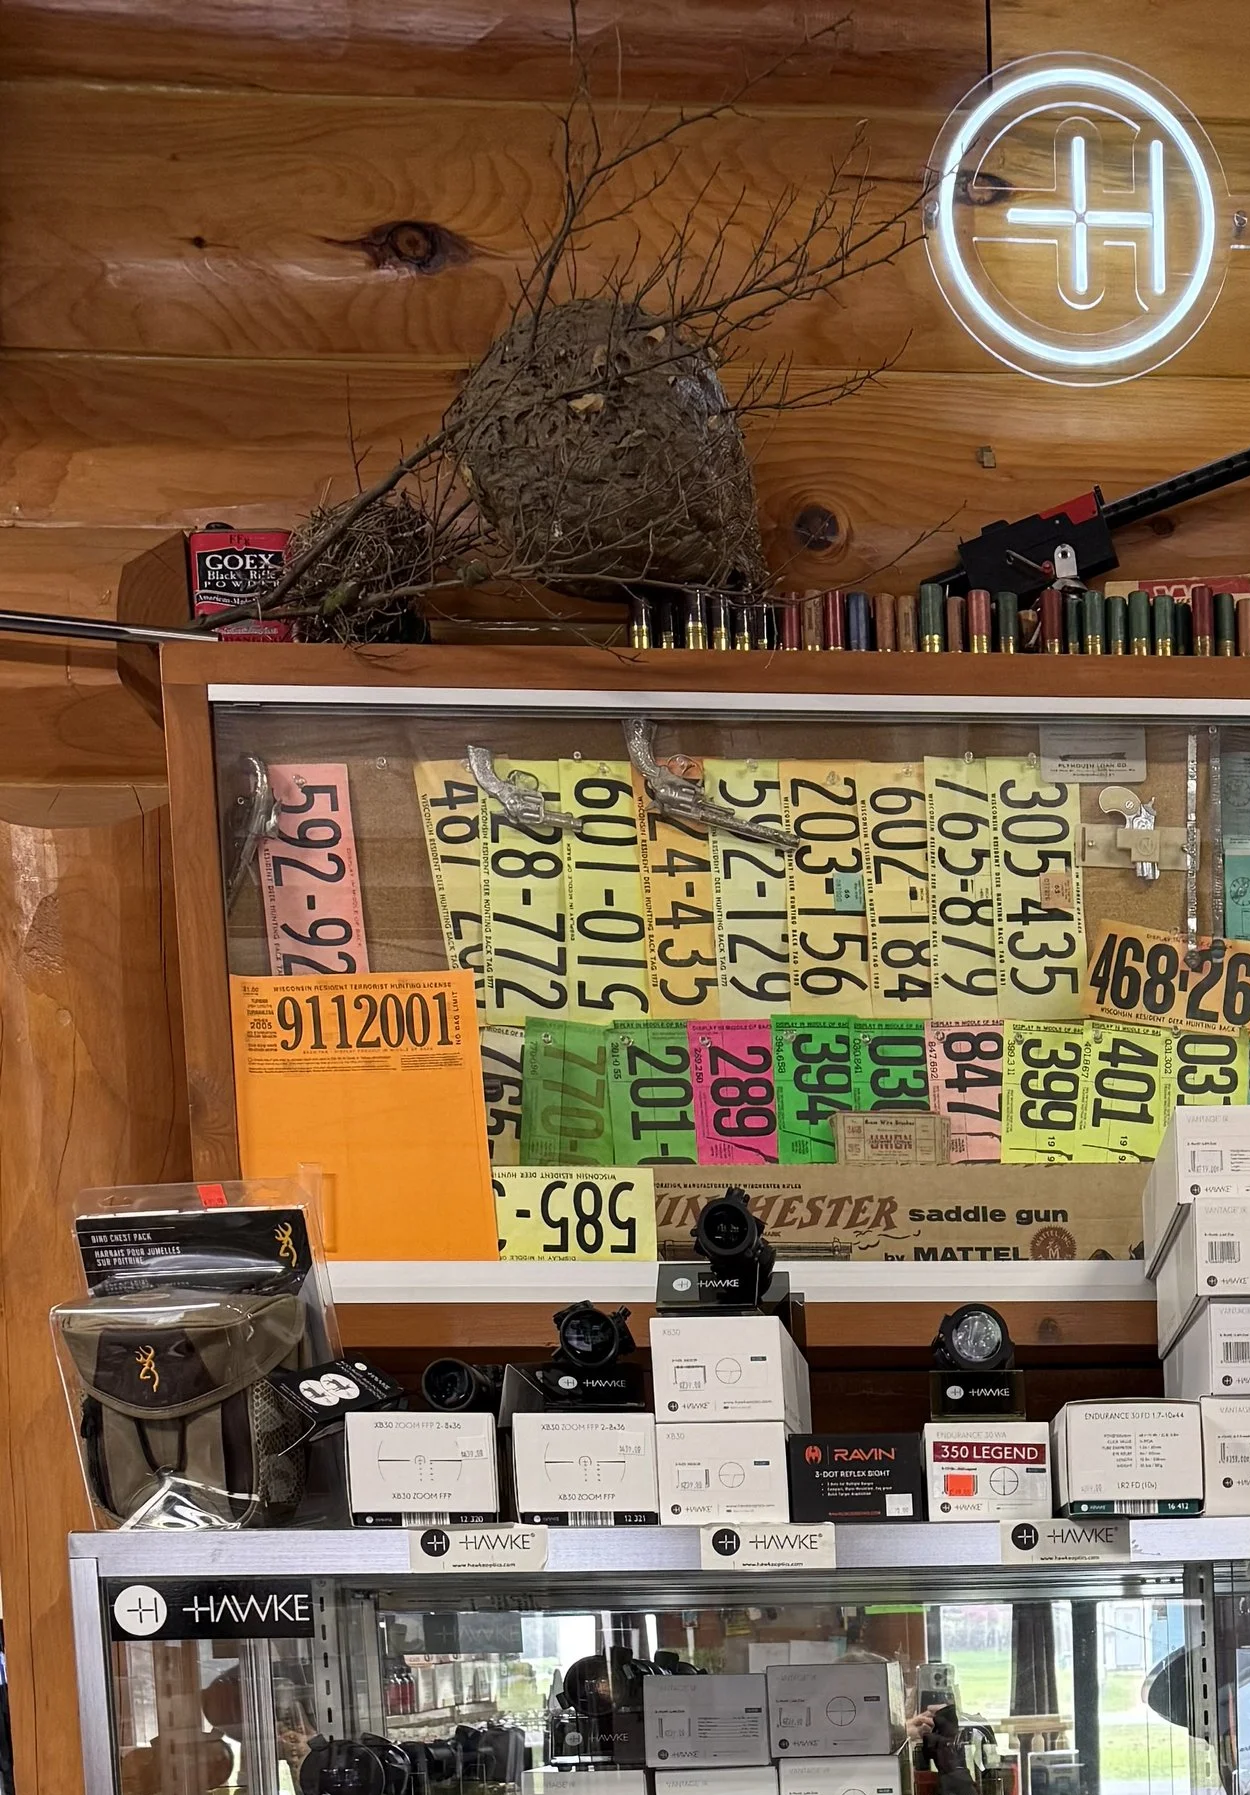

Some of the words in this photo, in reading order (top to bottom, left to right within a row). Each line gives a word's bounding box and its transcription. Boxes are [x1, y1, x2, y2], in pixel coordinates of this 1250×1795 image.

[205, 554, 275, 570] GOEX
[208, 570, 236, 580] Black
[789, 776, 869, 995] 203-156
[489, 792, 568, 1009] 28-772
[250, 1022, 272, 1030] 2005
[276, 991, 453, 1050] 9112001
[1101, 1007, 1133, 1019] WISCONSIN
[1136, 1013, 1165, 1023] RESIDENT
[1186, 1020, 1217, 1030] HUNTING
[456, 1033, 461, 1045] NO
[1018, 1038, 1083, 1131] 399
[1091, 1038, 1160, 1128] 401
[655, 1194, 899, 1231] INHESTER
[908, 1205, 1011, 1223] saddle
[1015, 1206, 1069, 1226] gun
[110, 1234, 131, 1242] CHEST
[134, 1233, 152, 1241] PACK
[914, 1245, 1027, 1261] MATTEL
[697, 1278, 739, 1288] HAWKE
[968, 1387, 1010, 1397] HAWKE
[834, 1448, 896, 1461] RAVIN
[941, 1445, 968, 1459] 350
[972, 1446, 1038, 1460] LEGEND
[815, 1470, 839, 1478] 3-DOT
[840, 1470, 865, 1478] REFLEX
[868, 1469, 890, 1478] SIGHT
[182, 1593, 310, 1623] HAWKE
